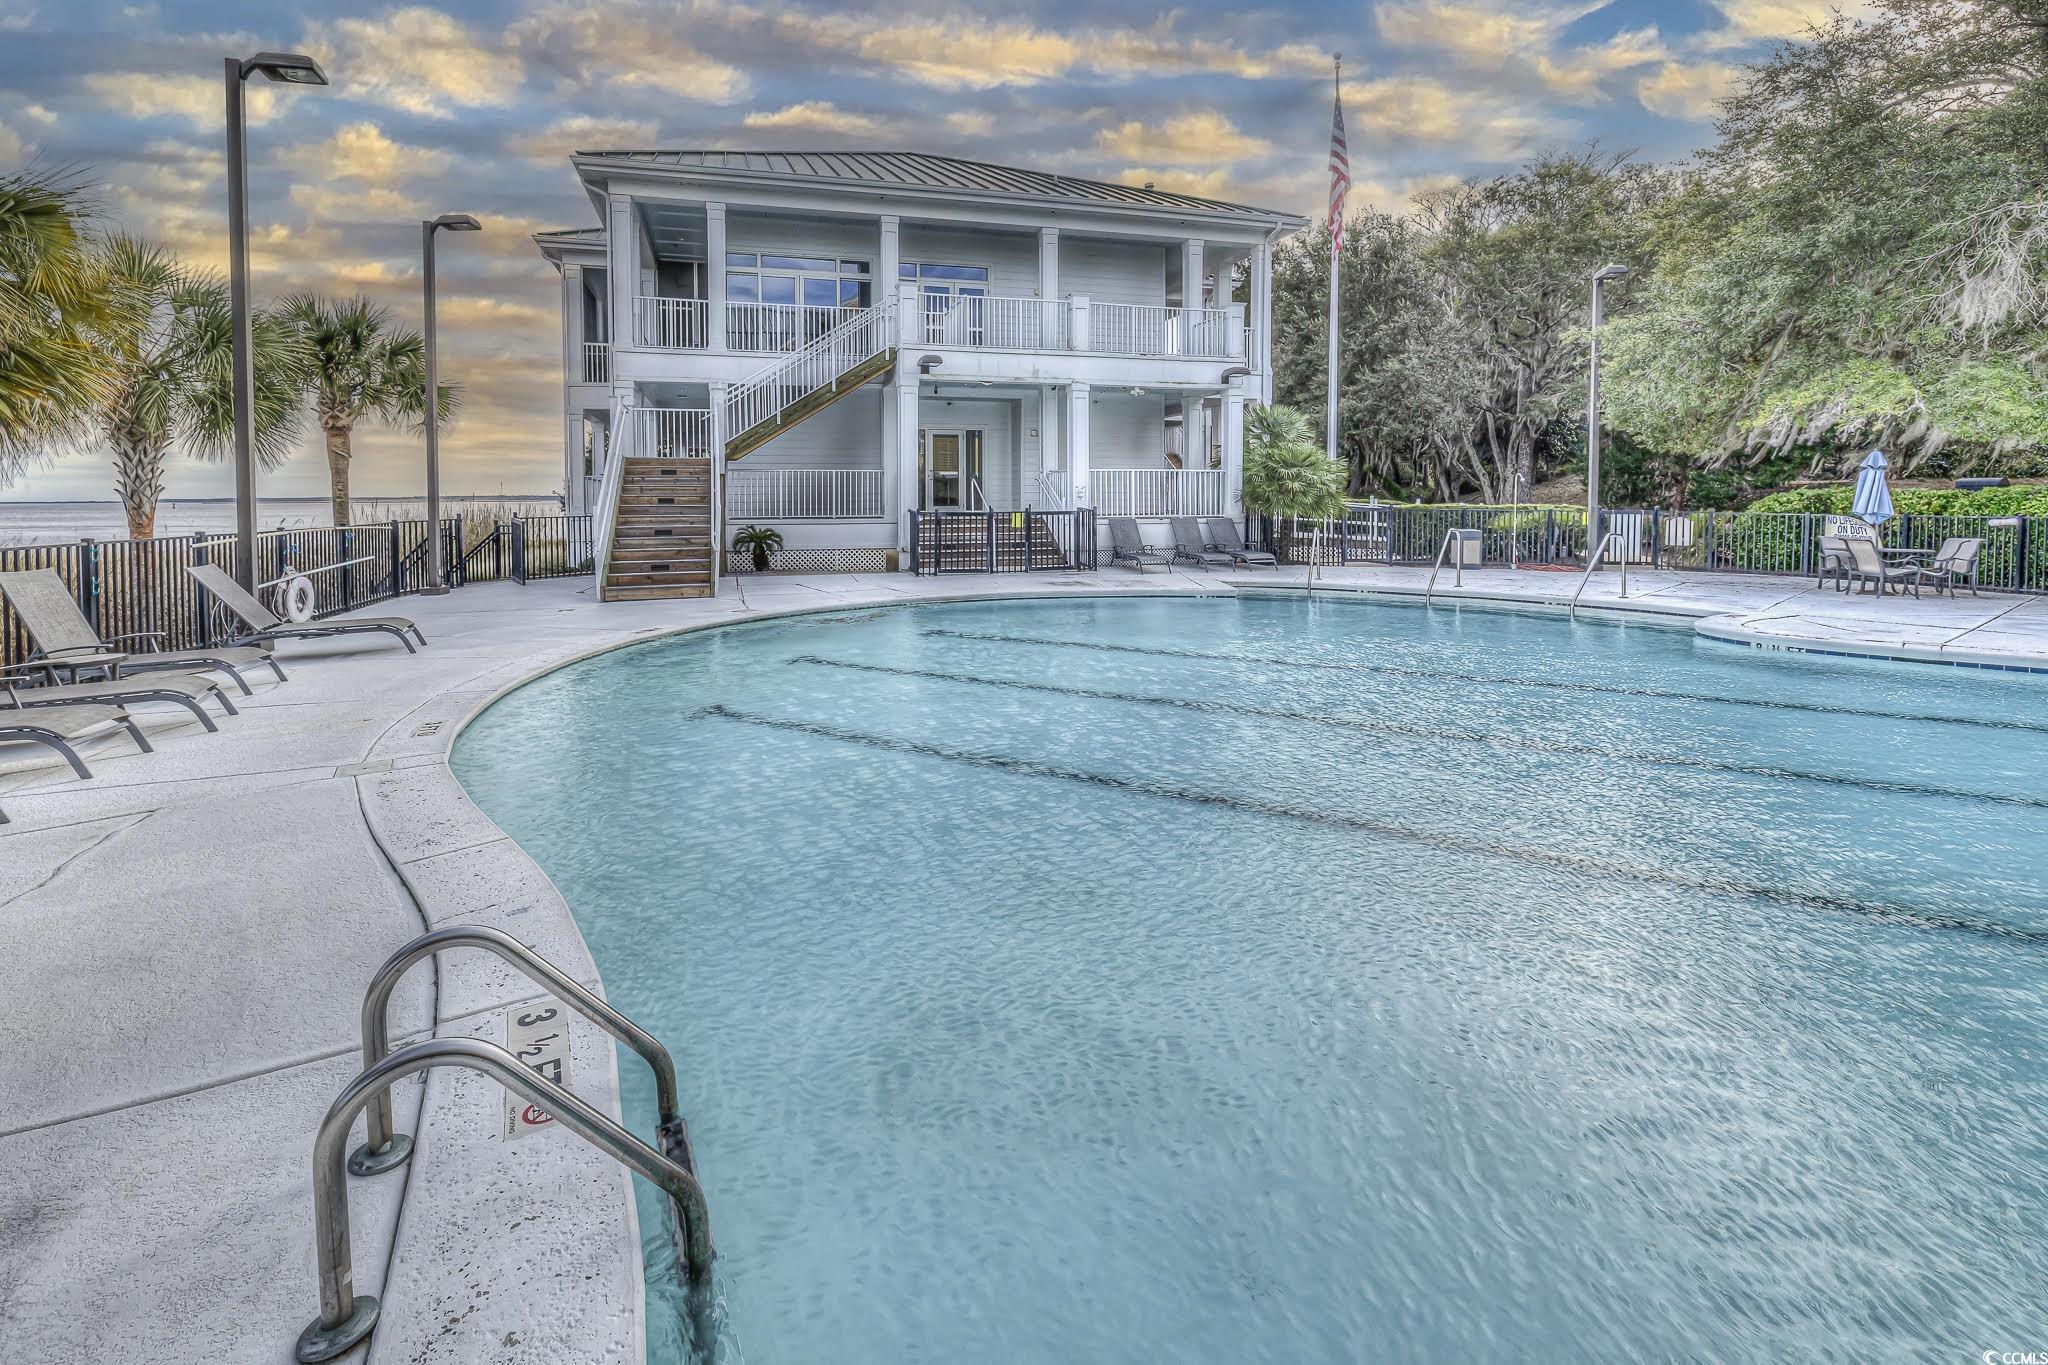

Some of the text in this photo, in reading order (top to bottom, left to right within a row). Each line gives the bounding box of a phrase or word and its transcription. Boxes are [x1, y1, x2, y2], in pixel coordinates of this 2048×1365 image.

[1827, 516, 1837, 525] NO
[1837, 525, 1868, 535] ON DUTY
[517, 1008, 558, 1027] 3
[508, 1106, 517, 1135] NO DIVING
